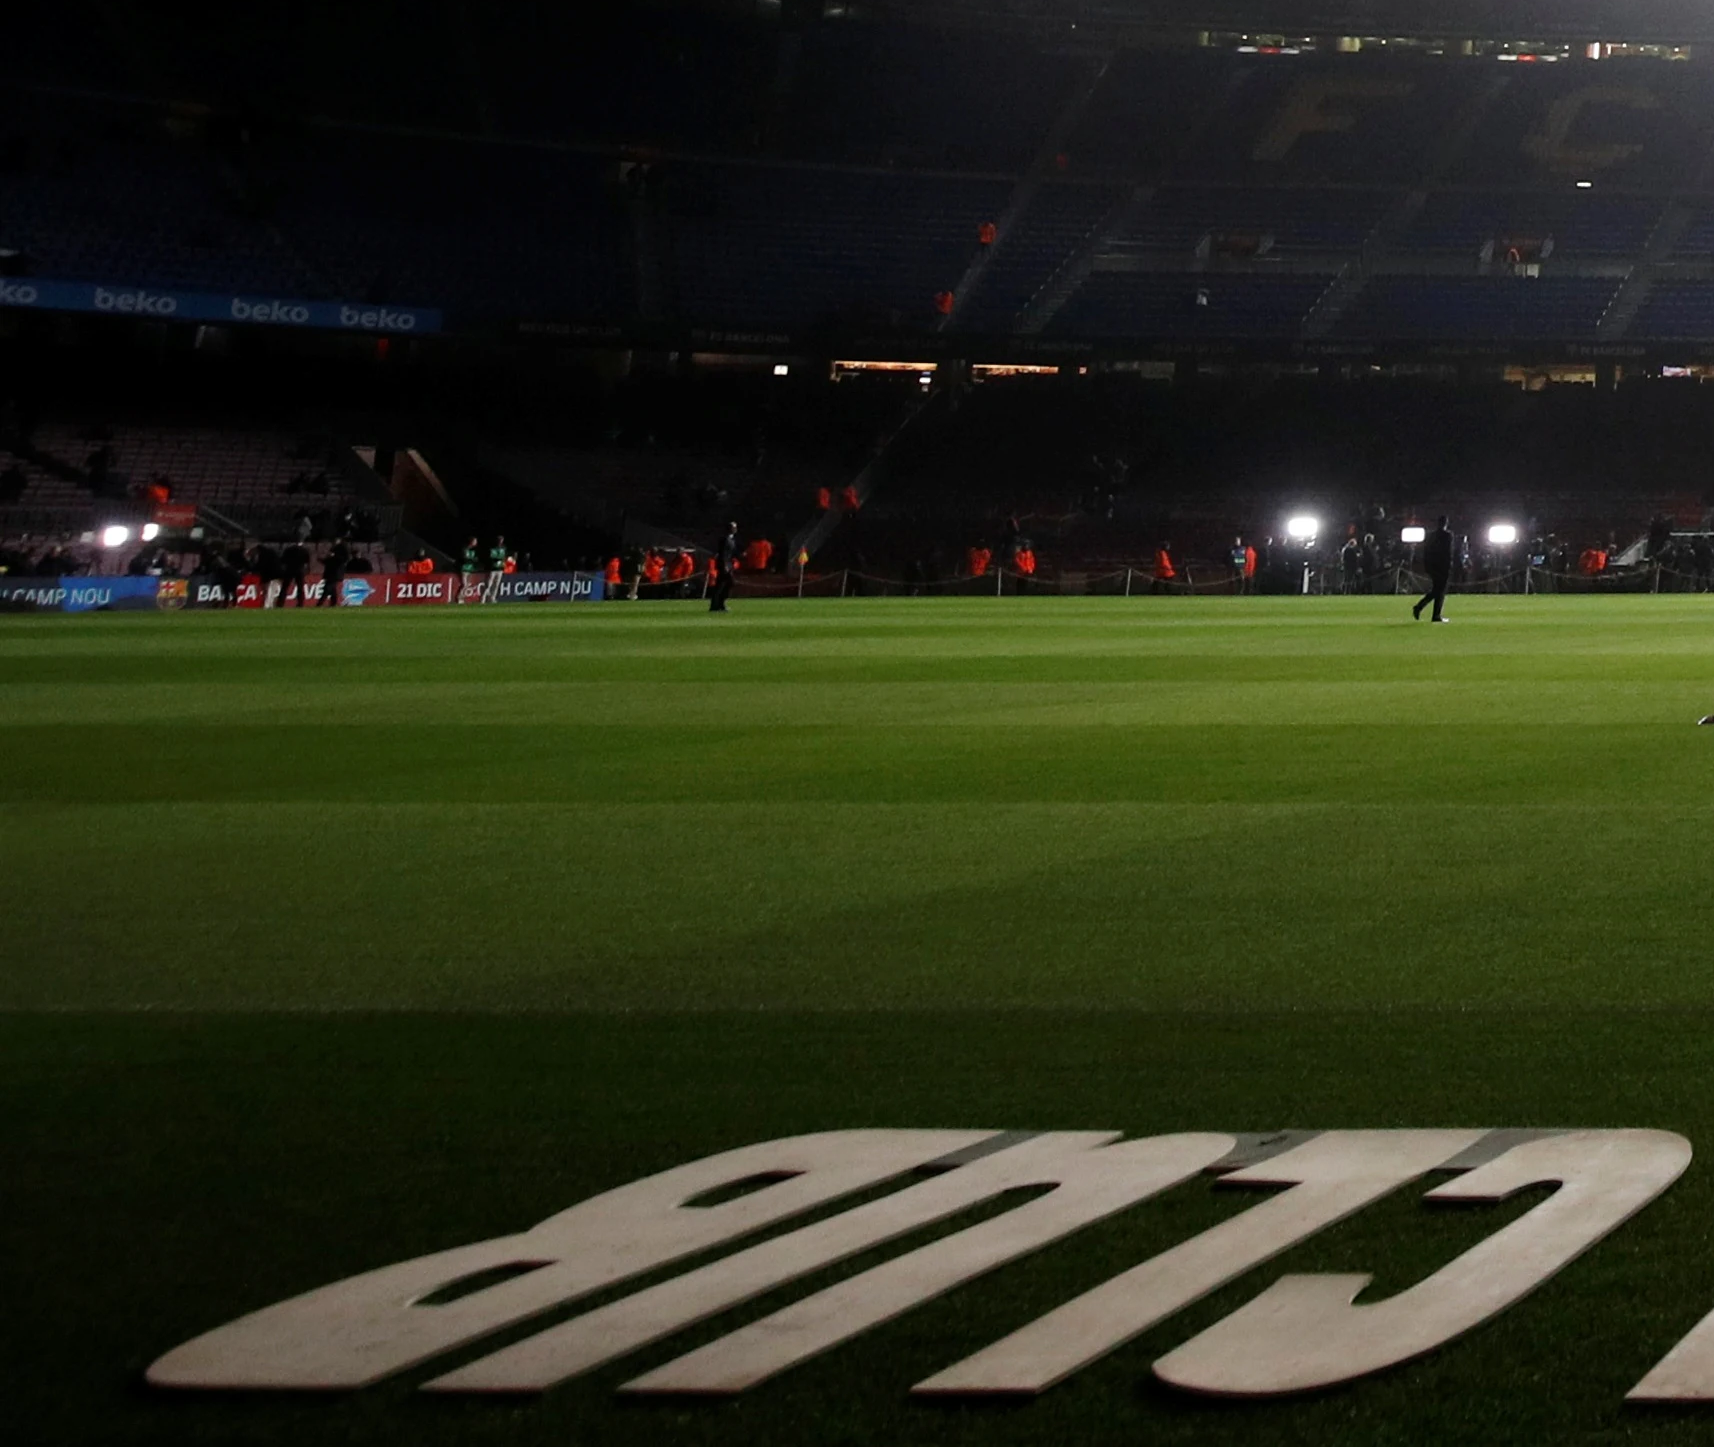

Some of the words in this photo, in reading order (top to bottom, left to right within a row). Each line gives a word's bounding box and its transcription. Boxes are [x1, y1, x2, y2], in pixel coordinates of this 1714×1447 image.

[94, 286, 177, 315] beko
[230, 297, 309, 324] beko
[340, 306, 416, 330] beko
[70, 588, 112, 605] NOU
[397, 583, 413, 599] 21
[416, 583, 442, 597] DIC
[514, 581, 557, 596] CAMP
[143, 1127, 1693, 1394] CLUB
